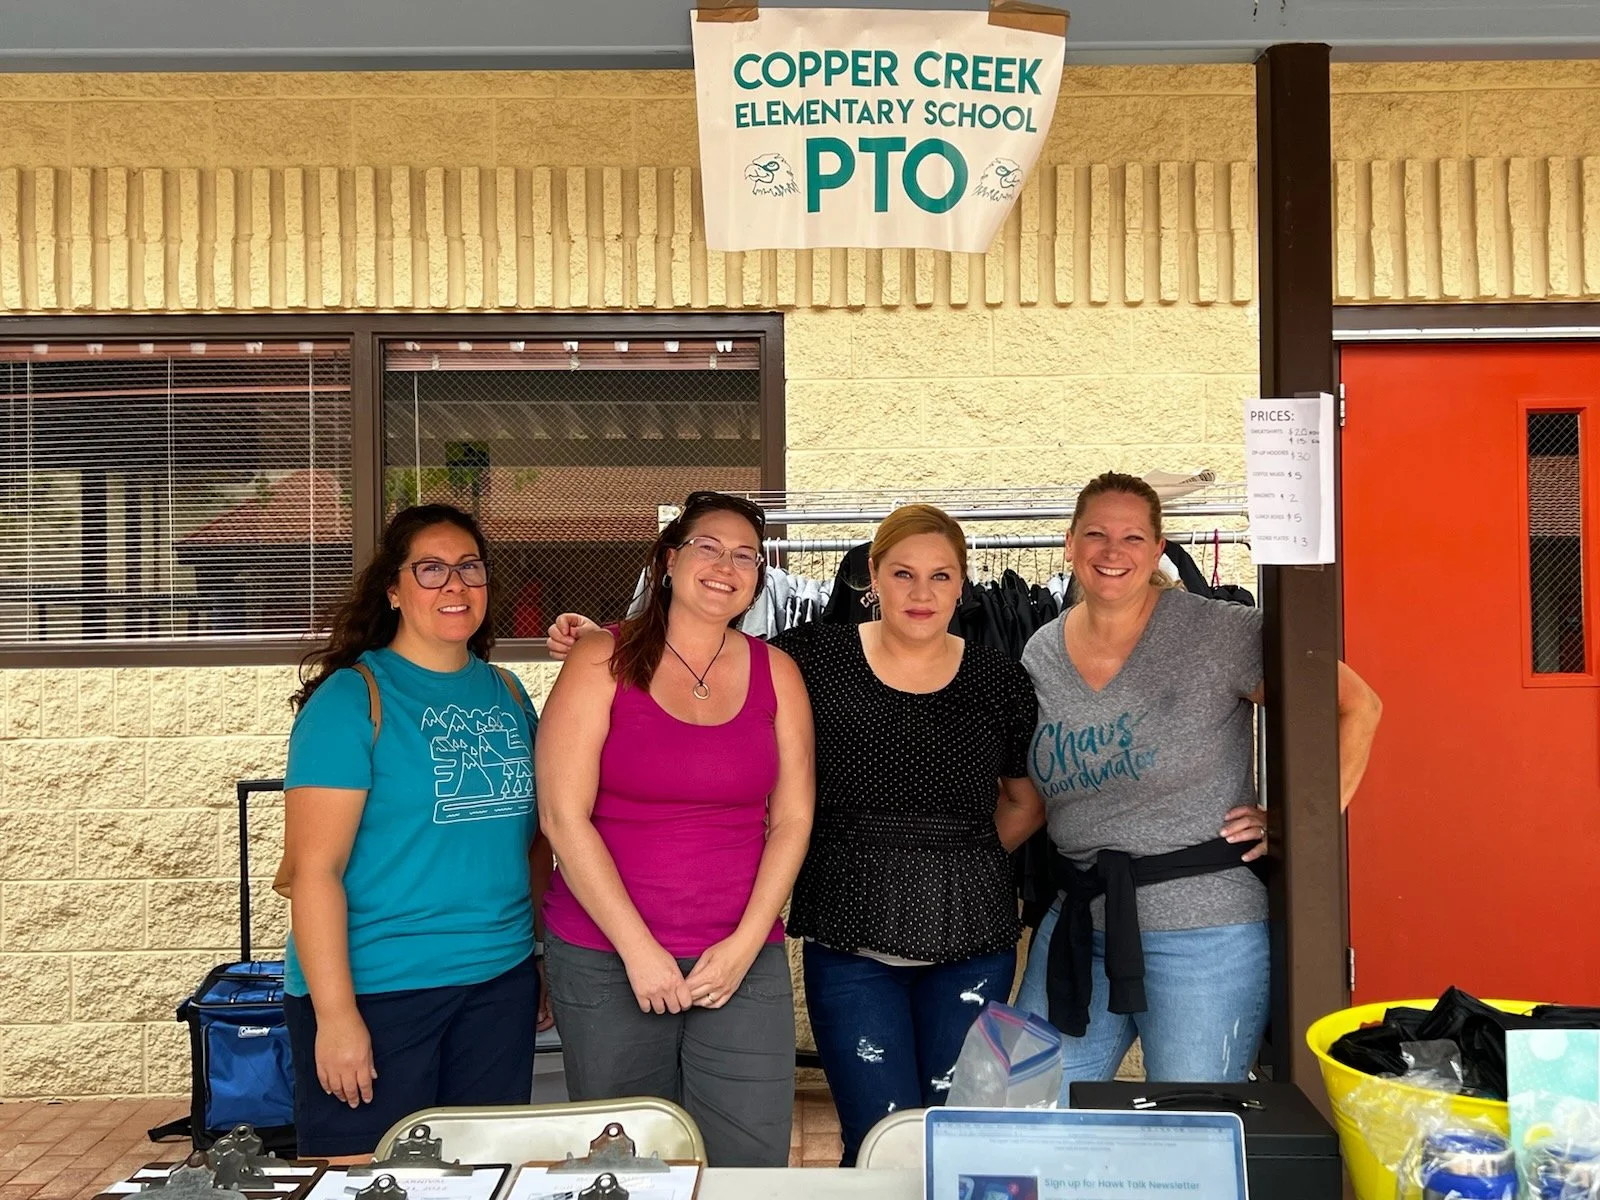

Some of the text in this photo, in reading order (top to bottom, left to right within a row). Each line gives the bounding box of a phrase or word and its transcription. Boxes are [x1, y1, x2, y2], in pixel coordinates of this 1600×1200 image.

[734, 50, 1043, 95] COPPER CREEK
[735, 99, 1037, 133] ELEMENTARY SCHOOL
[806, 136, 968, 214] PTO
[1250, 410, 1294, 421] PRICES:
[1044, 1178, 1201, 1191] Sign up for Hawk Talk Newsletter
